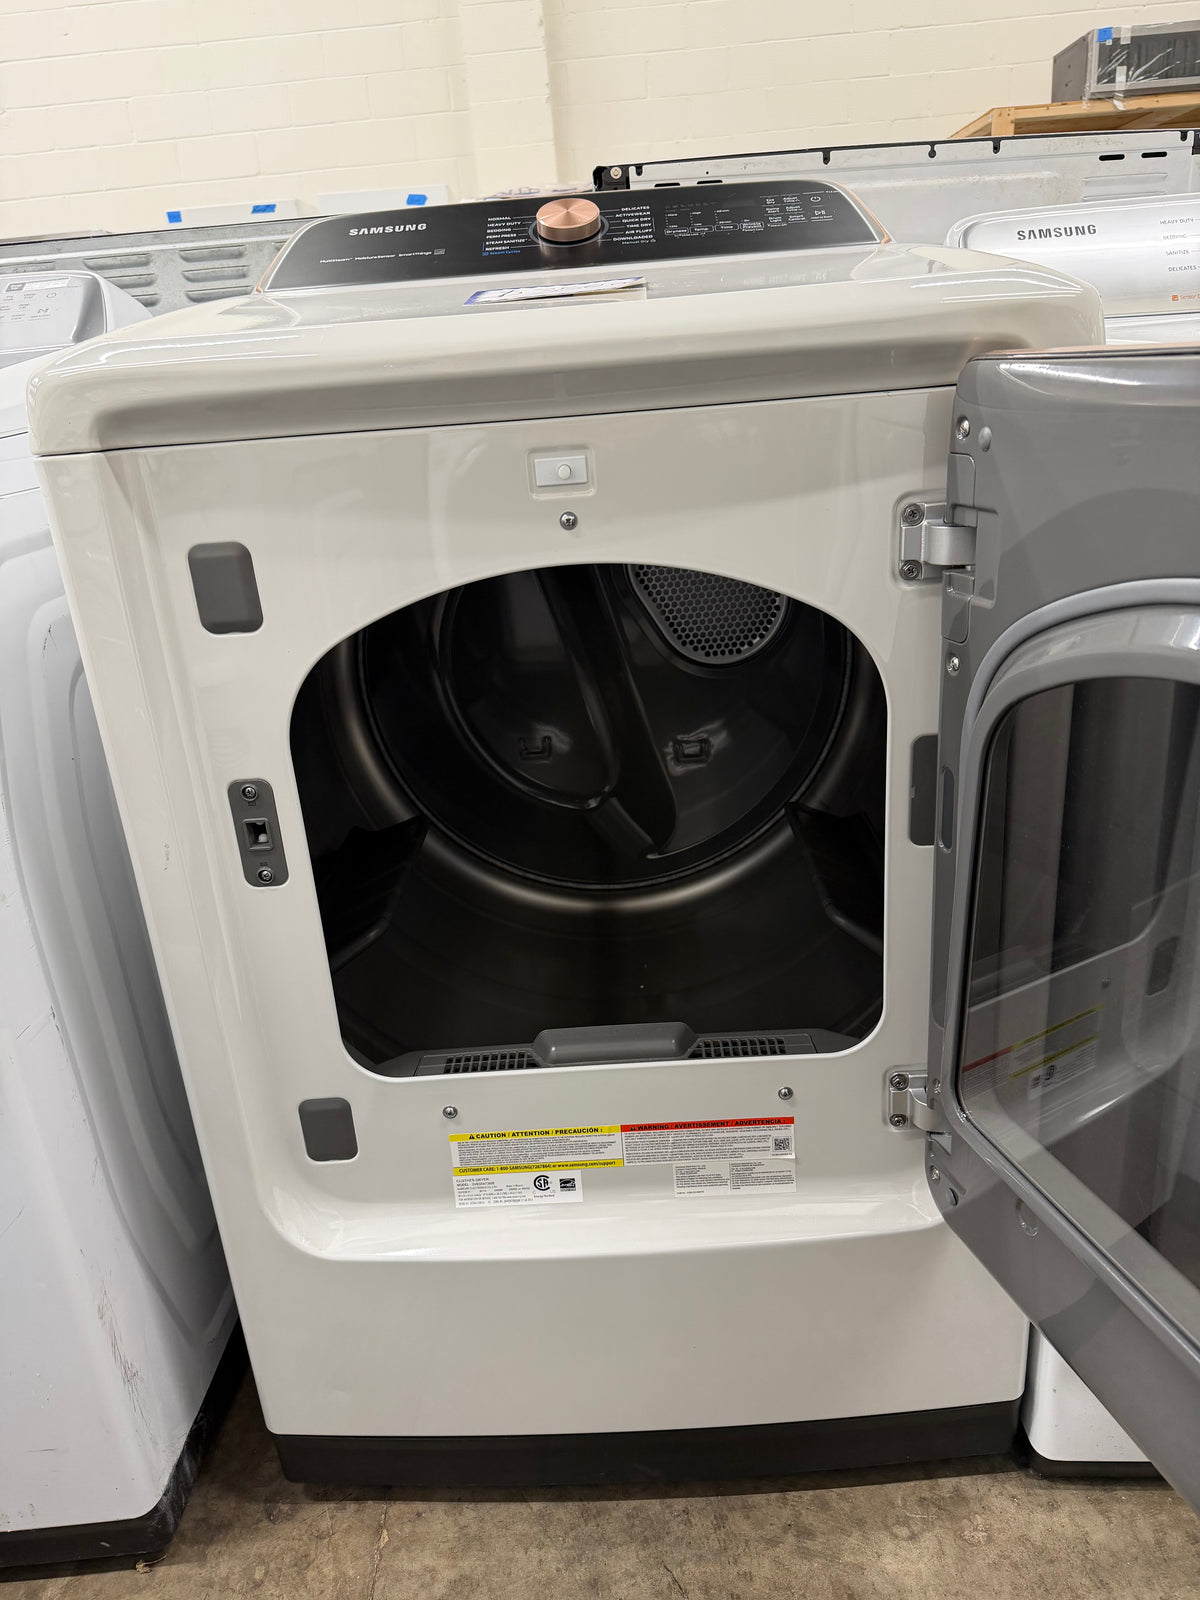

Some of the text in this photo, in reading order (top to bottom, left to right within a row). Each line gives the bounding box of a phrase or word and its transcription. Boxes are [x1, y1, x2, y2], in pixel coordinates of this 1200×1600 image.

[349, 223, 427, 236] SAMSUNG
[1017, 224, 1097, 241] SAMSUNG
[674, 1121, 730, 1129] AVERTISSEMENT
[557, 1161, 616, 1169] www.samsung.com/support
